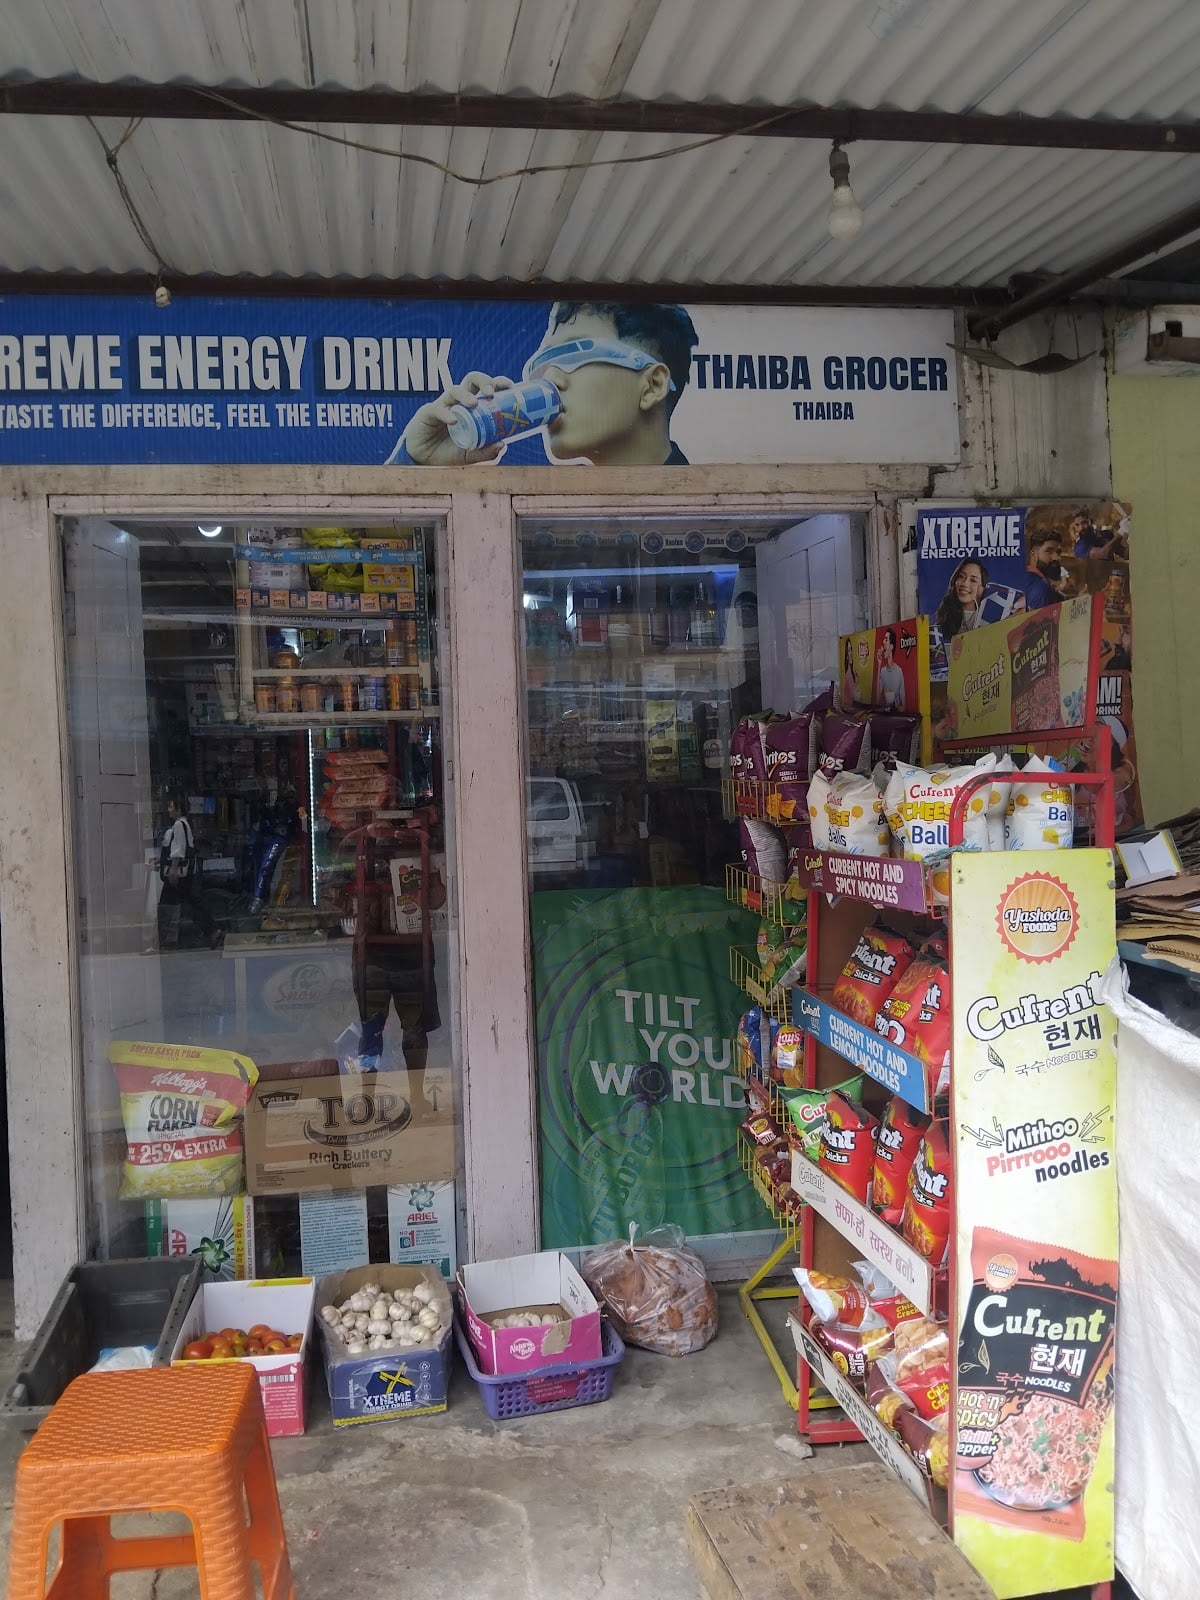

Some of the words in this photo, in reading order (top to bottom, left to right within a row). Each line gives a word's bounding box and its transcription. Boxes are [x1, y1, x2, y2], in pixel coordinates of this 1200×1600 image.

[137, 335, 307, 391] ENERGY
[322, 336, 453, 392] DRINK
[692, 353, 812, 391] THAIBA
[823, 355, 949, 392] GROCER
[59, 404, 97, 429] THE
[102, 403, 221, 431] DIFFERENCE,
[227, 404, 271, 428] FEEL
[276, 403, 312, 428] THE
[316, 403, 394, 428] ENERGY!
[793, 401, 854, 421] THAIBA
[921, 515, 1021, 551] XTREME
[920, 548, 976, 560] ENERGY
[977, 545, 1021, 558] DRINK
[828, 856, 862, 877] CURRENT
[863, 860, 880, 881] HOT
[883, 863, 904, 884] AND
[835, 876, 856, 896] SPICY
[857, 879, 899, 905] NOODLES
[1004, 907, 1071, 933] Yashoda
[1023, 921, 1058, 934] FOODS
[615, 989, 701, 1030] TILT
[966, 970, 1105, 1044] Current
[775, 1029, 802, 1048] Lay's
[828, 1013, 866, 1049] CURRENT
[865, 1035, 884, 1062] HOT
[886, 1049, 908, 1077] AND
[1042, 1013, 1103, 1051] 현재
[130, 1044, 154, 1055] SUPER
[155, 1046, 180, 1058] SAVER
[829, 1030, 859, 1065] LEMON
[858, 1053, 901, 1093] NOODLES
[150, 1070, 209, 1094] Kellogg's
[1014, 1060, 1046, 1078] 국수
[149, 1094, 201, 1121] CORN
[315, 1092, 399, 1129] TOP
[1005, 1116, 1079, 1154] Mithoo
[308, 1150, 340, 1165] Rich
[343, 1148, 393, 1163] Buttery
[332, 1160, 371, 1171] Crackers
[1034, 1148, 1111, 1184] noodles
[407, 1211, 438, 1222] ARIEL
[973, 1293, 1107, 1344] Current
[1030, 1342, 1089, 1378] 현재
[995, 1371, 1024, 1387] 국수
[363, 1390, 412, 1407] XTREME
